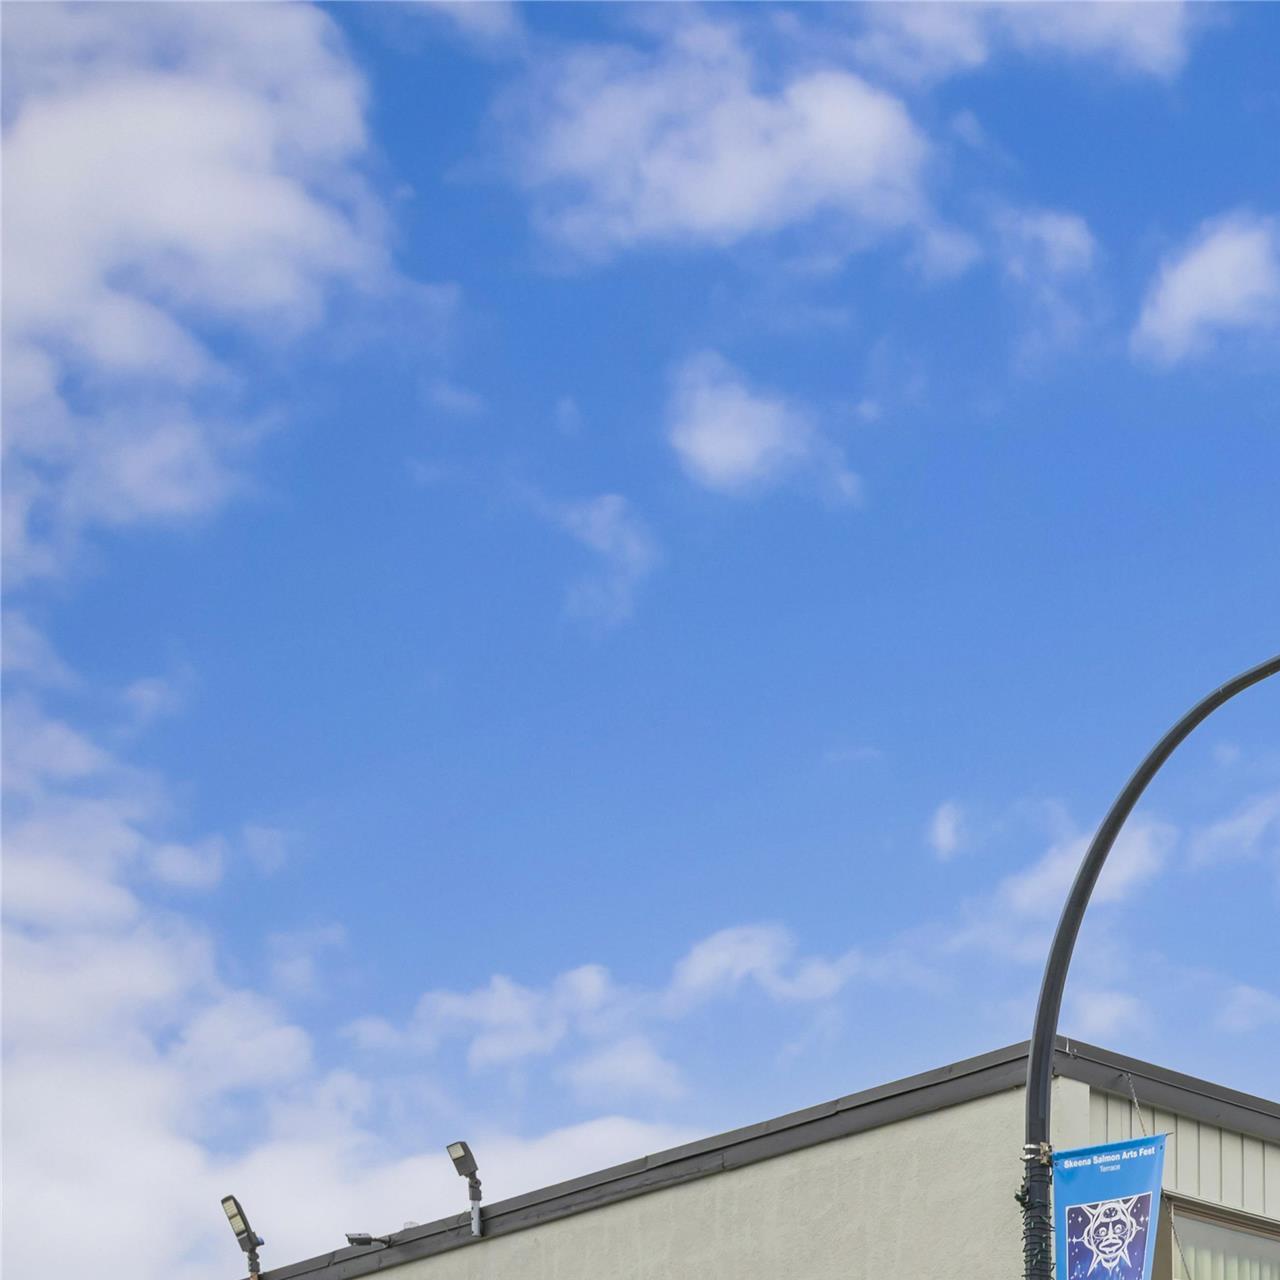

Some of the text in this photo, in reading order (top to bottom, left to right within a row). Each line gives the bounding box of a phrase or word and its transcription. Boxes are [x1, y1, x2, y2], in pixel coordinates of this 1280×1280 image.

[1063, 1146, 1156, 1169] Skeena Salmon Arts Fest
